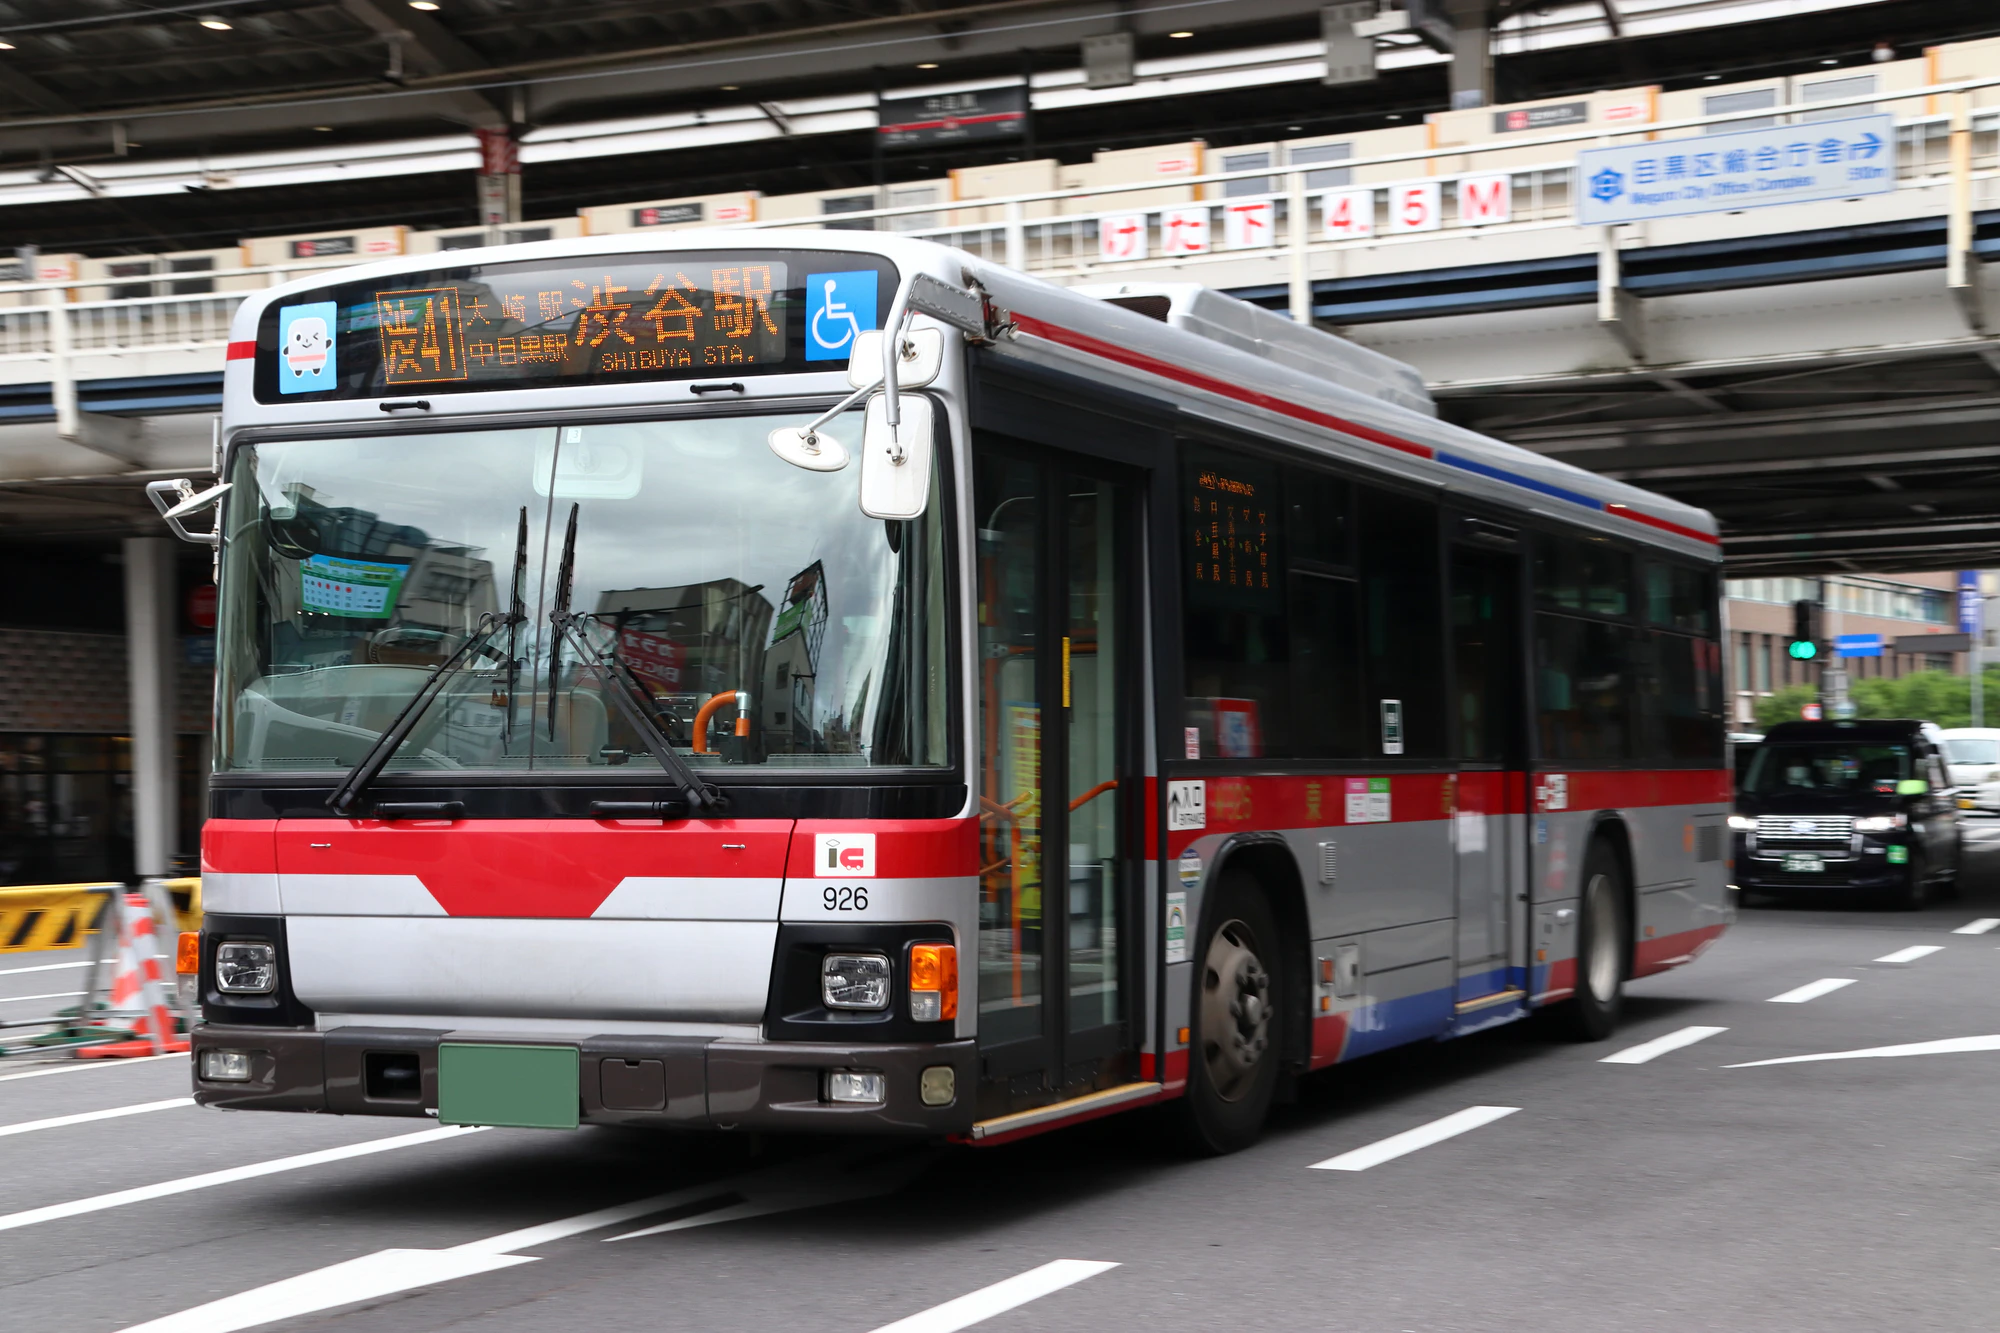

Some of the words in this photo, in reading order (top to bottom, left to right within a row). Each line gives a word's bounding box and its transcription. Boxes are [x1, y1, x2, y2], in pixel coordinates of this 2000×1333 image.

[1630, 138, 1844, 184] 目黒区総合庁舎
[1101, 203, 1272, 257] けた下
[571, 265, 778, 347] 渋谷駅
[469, 333, 570, 367] 中目黒駅
[601, 347, 692, 372] SHIBUYA
[703, 344, 755, 366] STA.
[823, 887, 868, 911] 926
